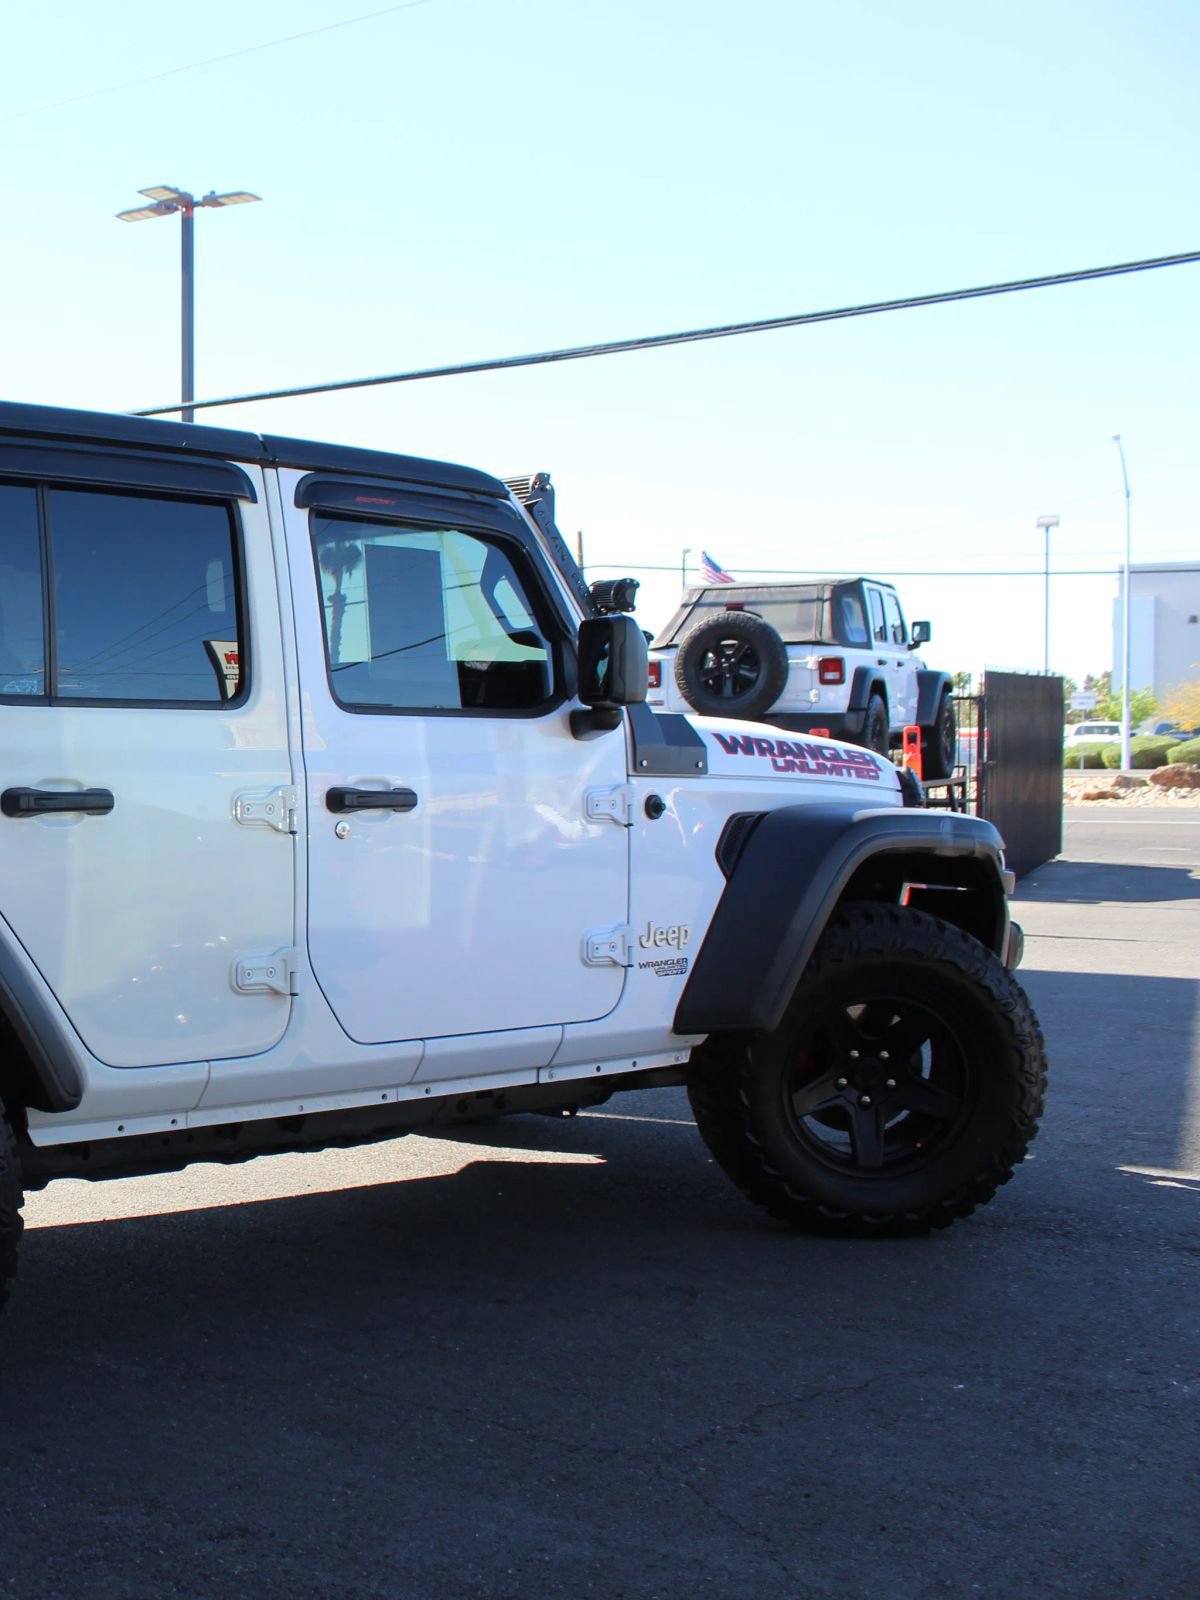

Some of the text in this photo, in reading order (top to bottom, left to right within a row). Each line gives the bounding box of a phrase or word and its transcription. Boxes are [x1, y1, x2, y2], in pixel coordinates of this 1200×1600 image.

[712, 733, 883, 771] WRANGLER
[771, 758, 880, 780] UNLIMITED
[639, 921, 689, 950] Jeep
[638, 957, 688, 969] WRANGLER
